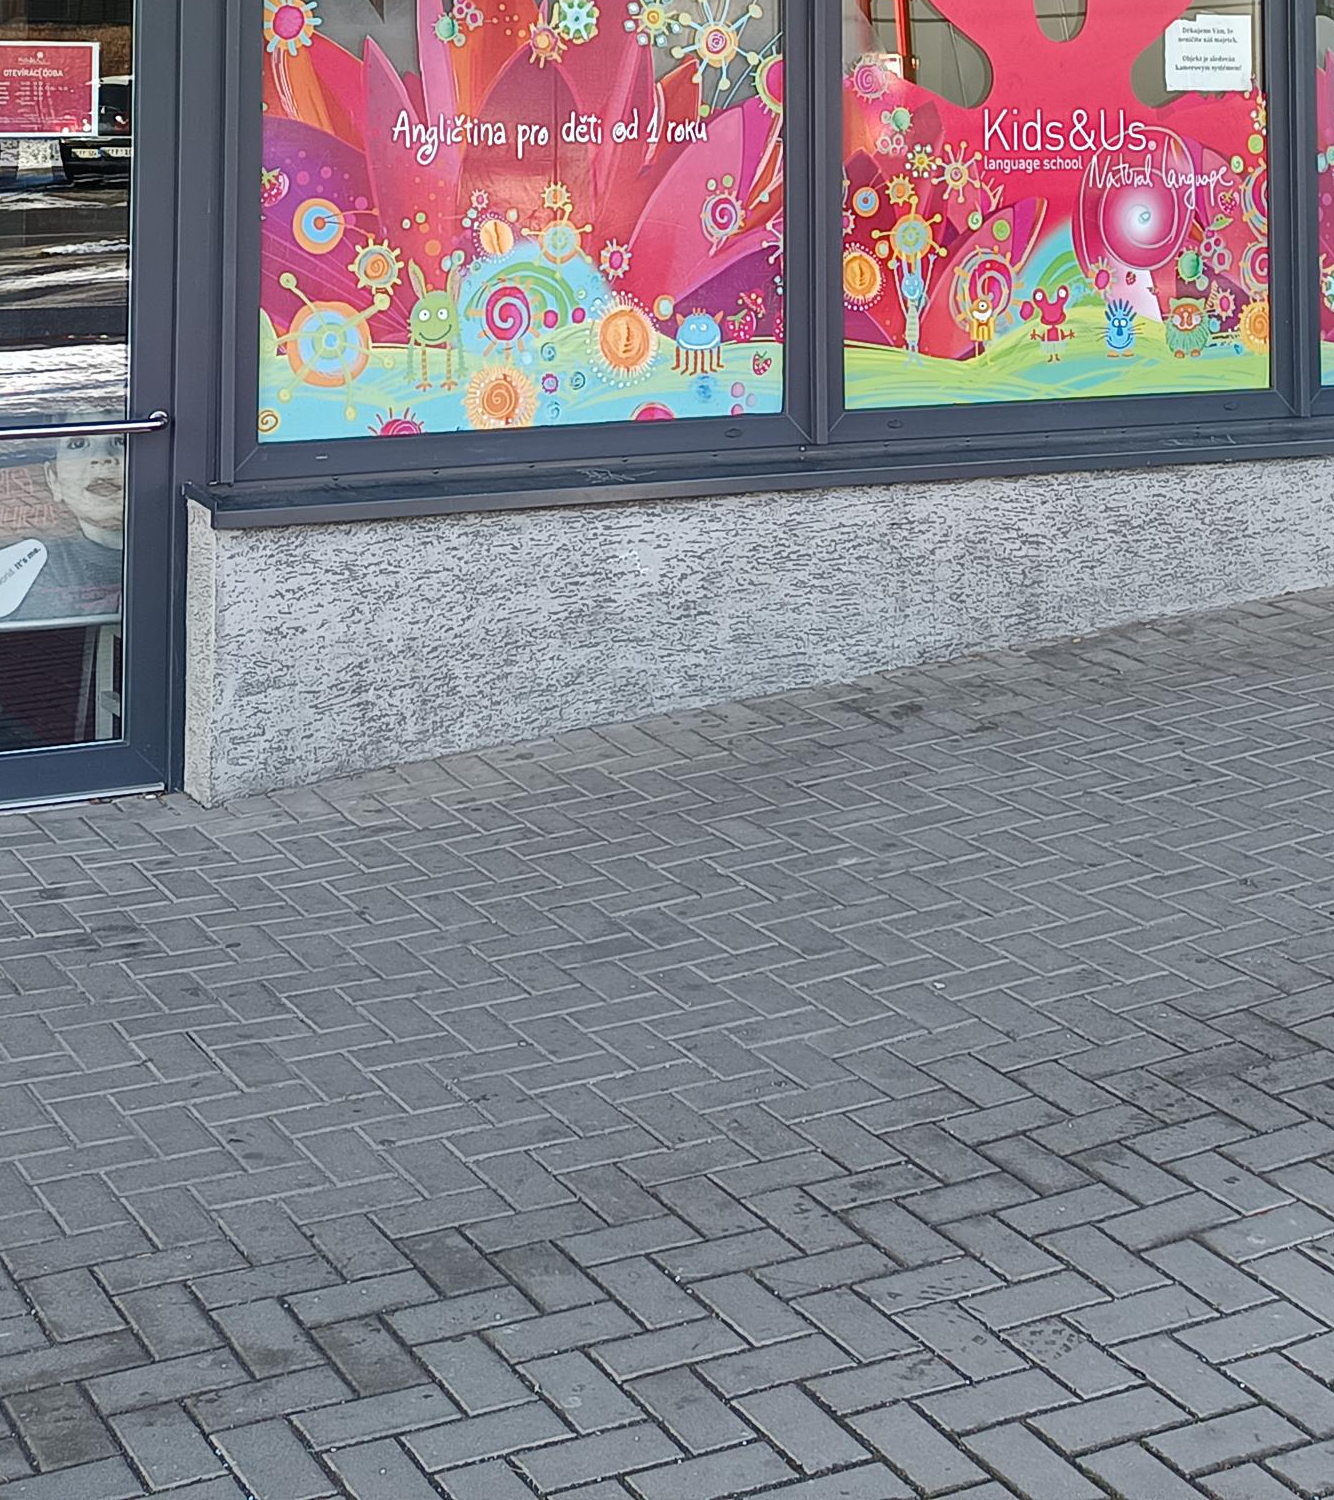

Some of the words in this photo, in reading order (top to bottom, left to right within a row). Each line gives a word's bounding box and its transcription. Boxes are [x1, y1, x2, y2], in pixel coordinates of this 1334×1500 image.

[391, 109, 507, 166] Angličtina
[516, 124, 549, 160] pro
[561, 111, 603, 145] děti
[612, 108, 639, 143] od
[646, 107, 660, 144] 1
[666, 117, 709, 143] roku
[984, 156, 1041, 174] language
[1042, 155, 1084, 170] school
[1088, 153, 1155, 189] Natural
[1161, 134, 1235, 209] language
